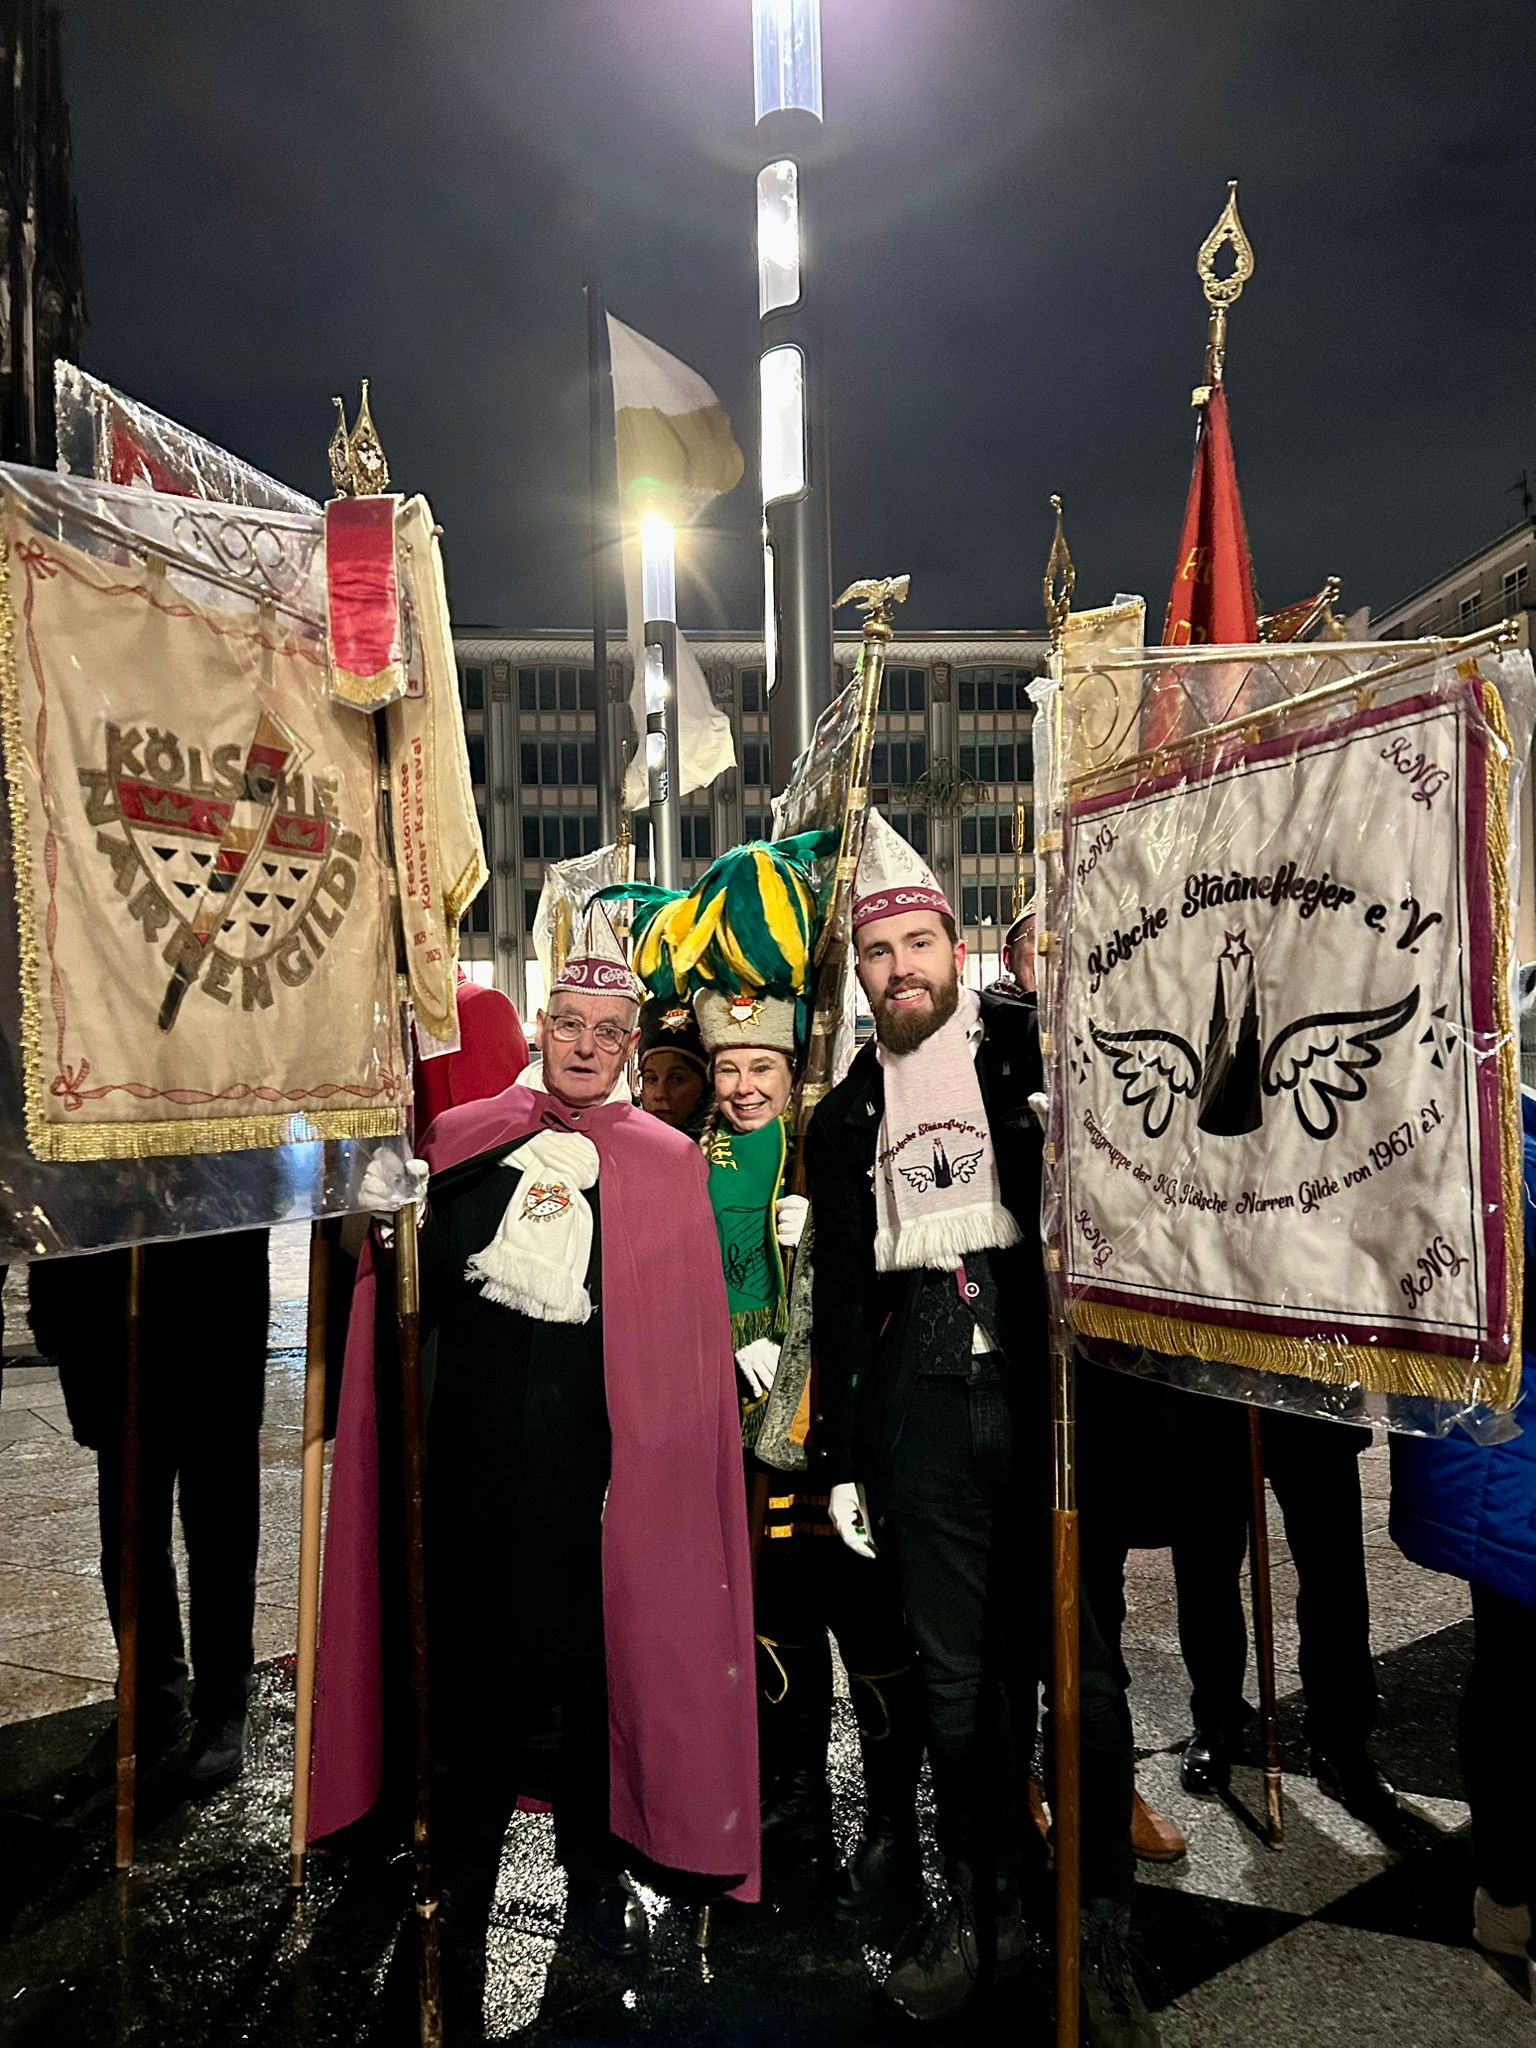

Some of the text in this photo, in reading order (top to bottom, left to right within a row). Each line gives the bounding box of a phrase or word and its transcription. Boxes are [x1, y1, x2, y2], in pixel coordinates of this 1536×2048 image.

[104, 721, 339, 818] KÖLSCHE
[1381, 737, 1450, 810] KNG
[400, 762, 415, 897] Festkomitee
[411, 736, 431, 911] Kölner Karneval
[1088, 906, 1168, 993] Kölsche
[1083, 1108, 1132, 1170] Tanzgruppe
[1133, 1164, 1151, 1183] der
[1179, 1184, 1228, 1213] Kölsche
[1235, 1192, 1294, 1214] Narren
[1299, 1177, 1340, 1213] Gilde
[1343, 1165, 1372, 1188] von
[1368, 1122, 1415, 1171] 1967
[1401, 1236, 1469, 1310] KNG
